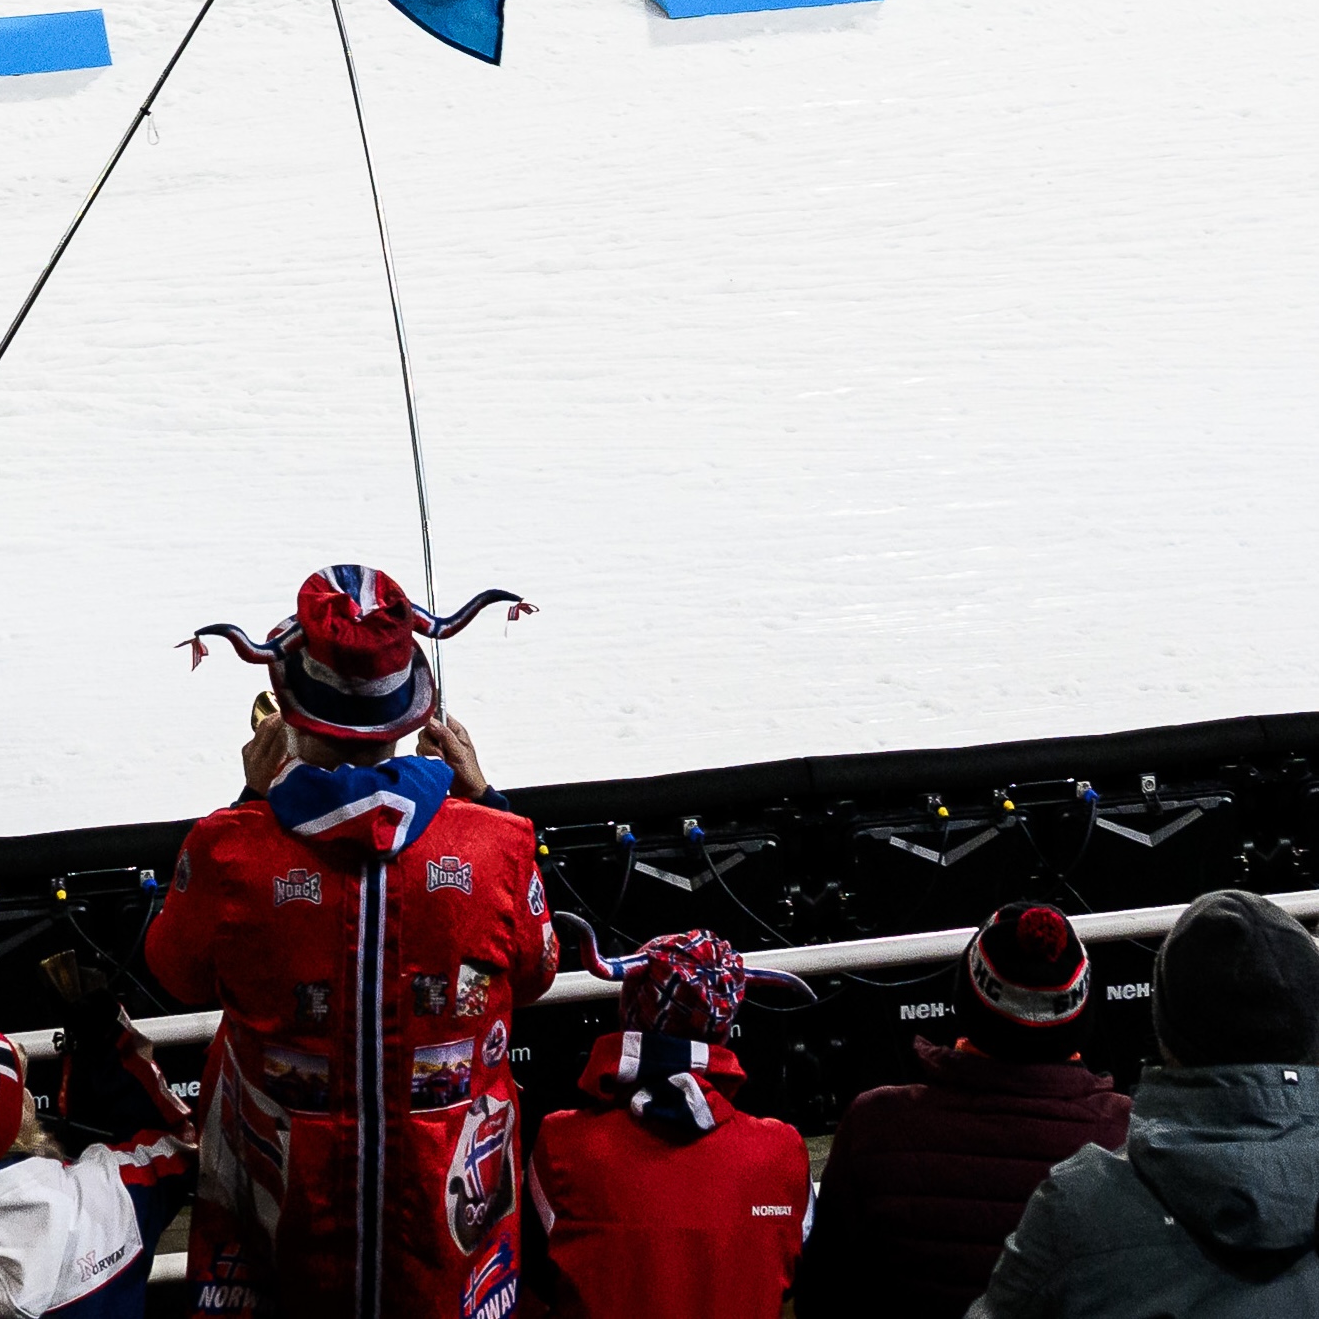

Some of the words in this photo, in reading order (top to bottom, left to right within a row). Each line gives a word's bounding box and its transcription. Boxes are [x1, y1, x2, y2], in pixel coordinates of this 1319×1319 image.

[273, 873, 321, 906] NORGE
[427, 862, 472, 894] NORGE
[76, 1245, 126, 1283] NORWAY
